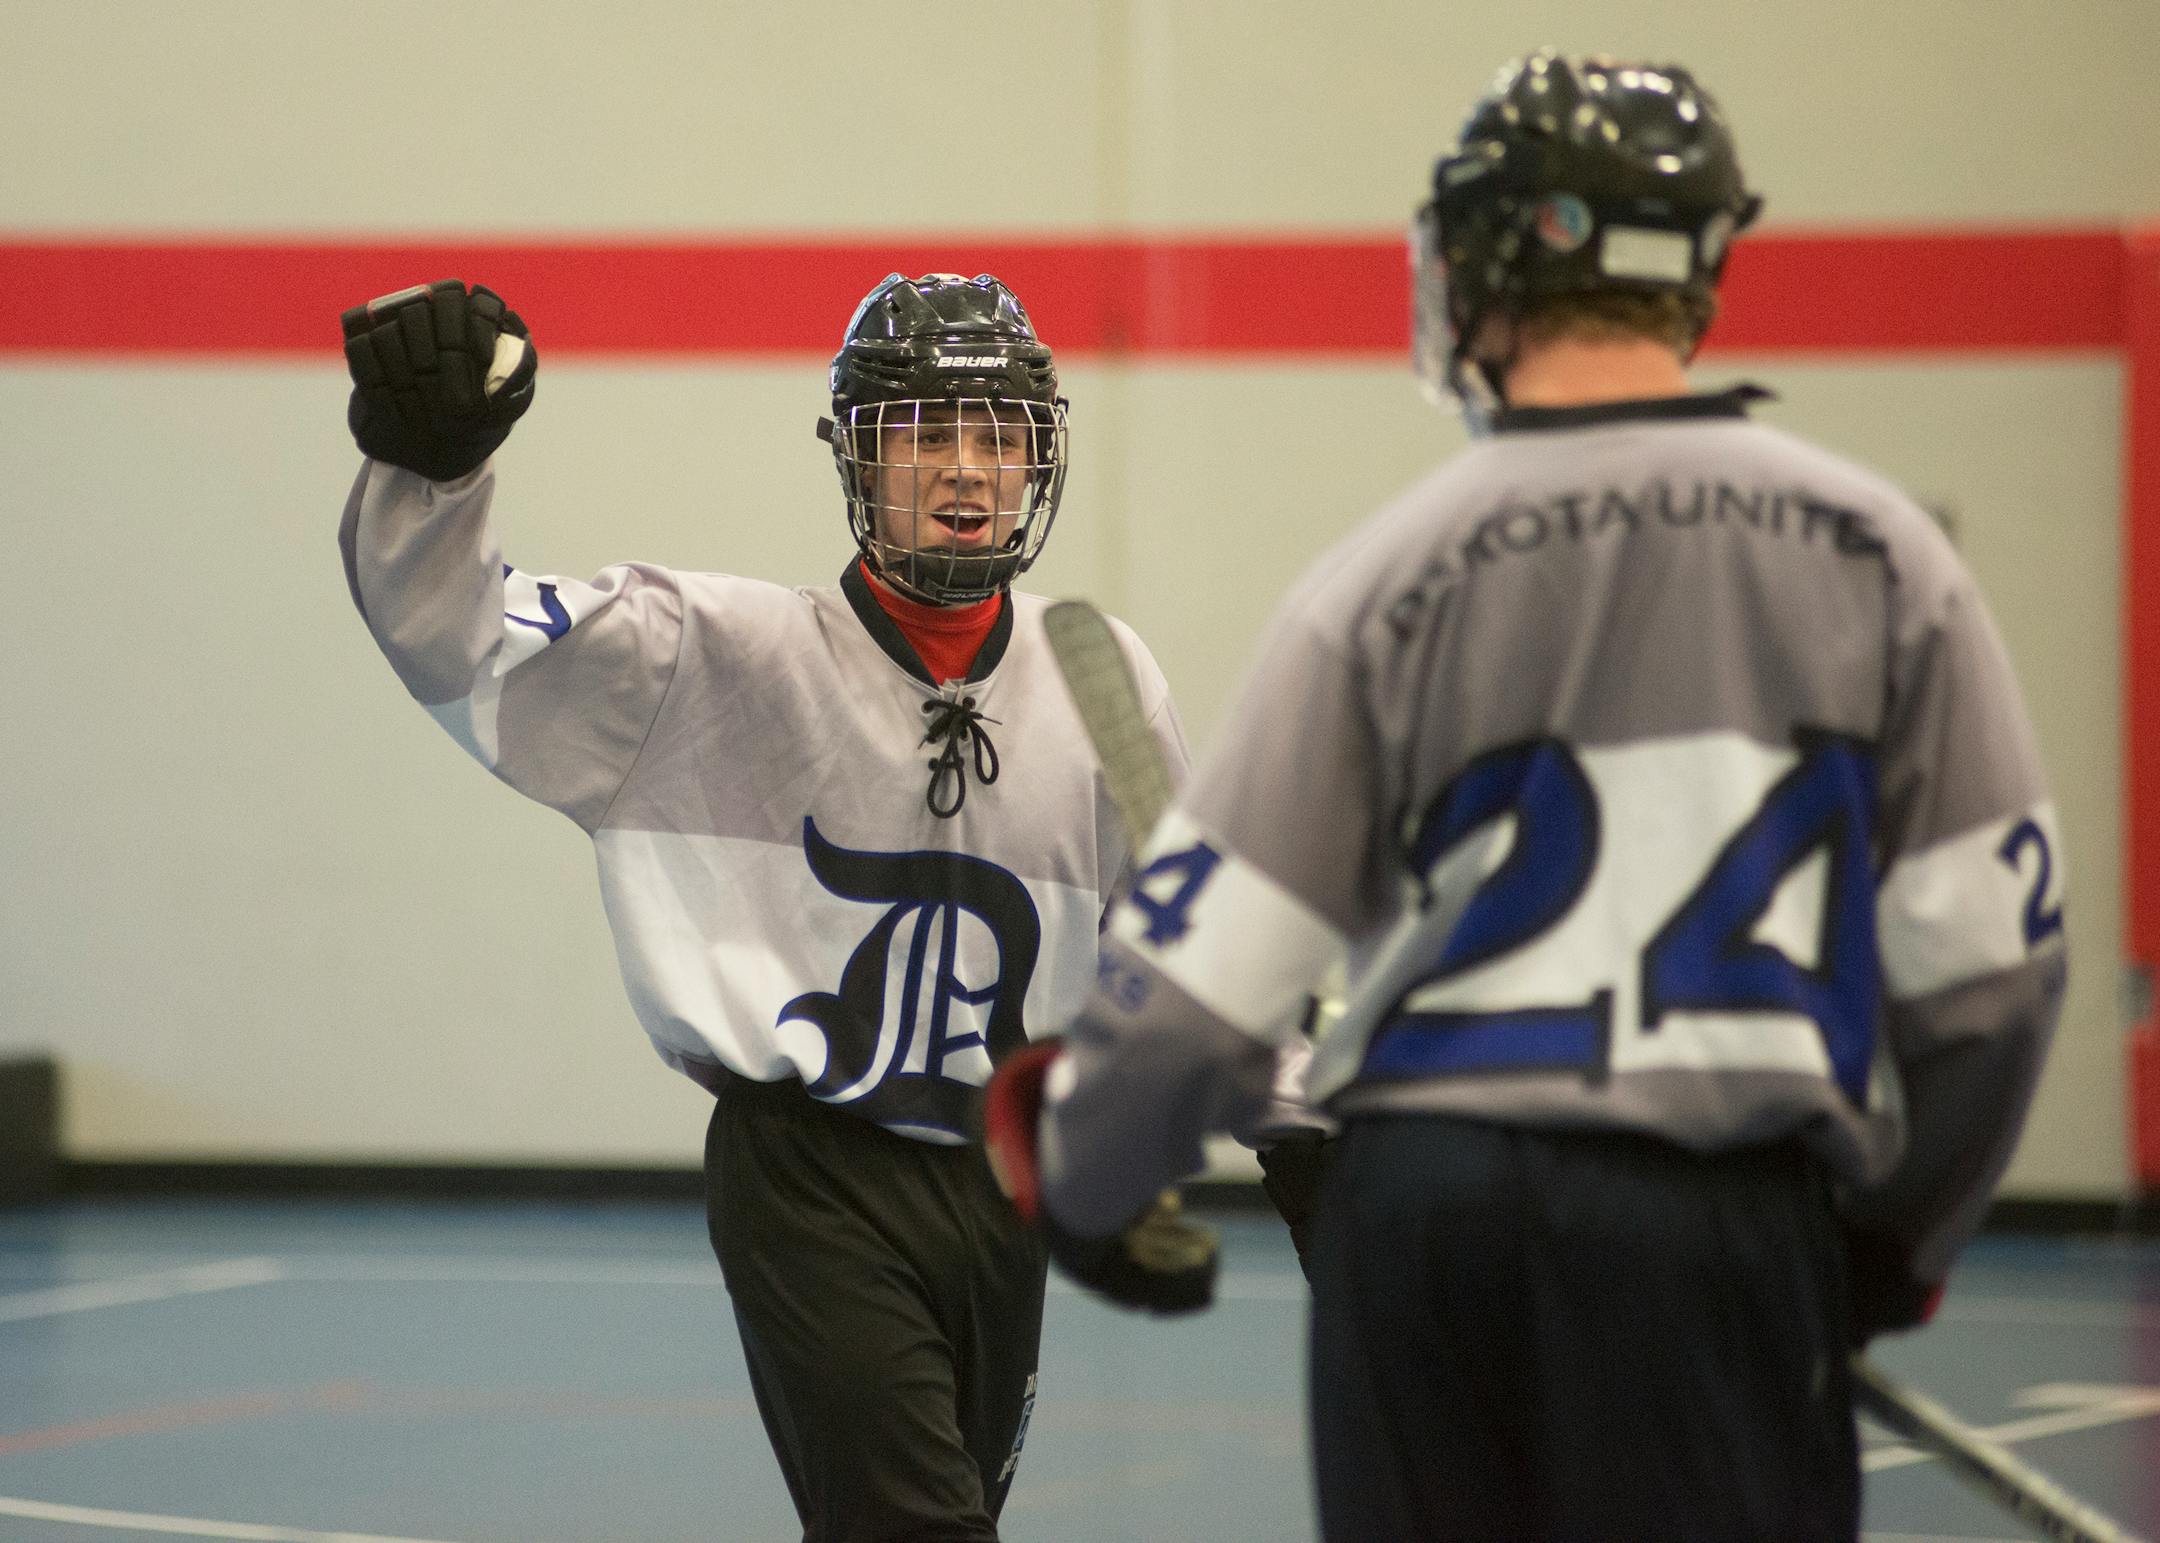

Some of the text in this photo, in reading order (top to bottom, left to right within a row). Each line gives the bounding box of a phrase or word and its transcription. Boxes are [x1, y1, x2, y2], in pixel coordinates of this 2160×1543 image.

[1131, 841, 1222, 946] 4
[1352, 724, 1882, 1112] 24
[1996, 816, 2063, 946] 2
